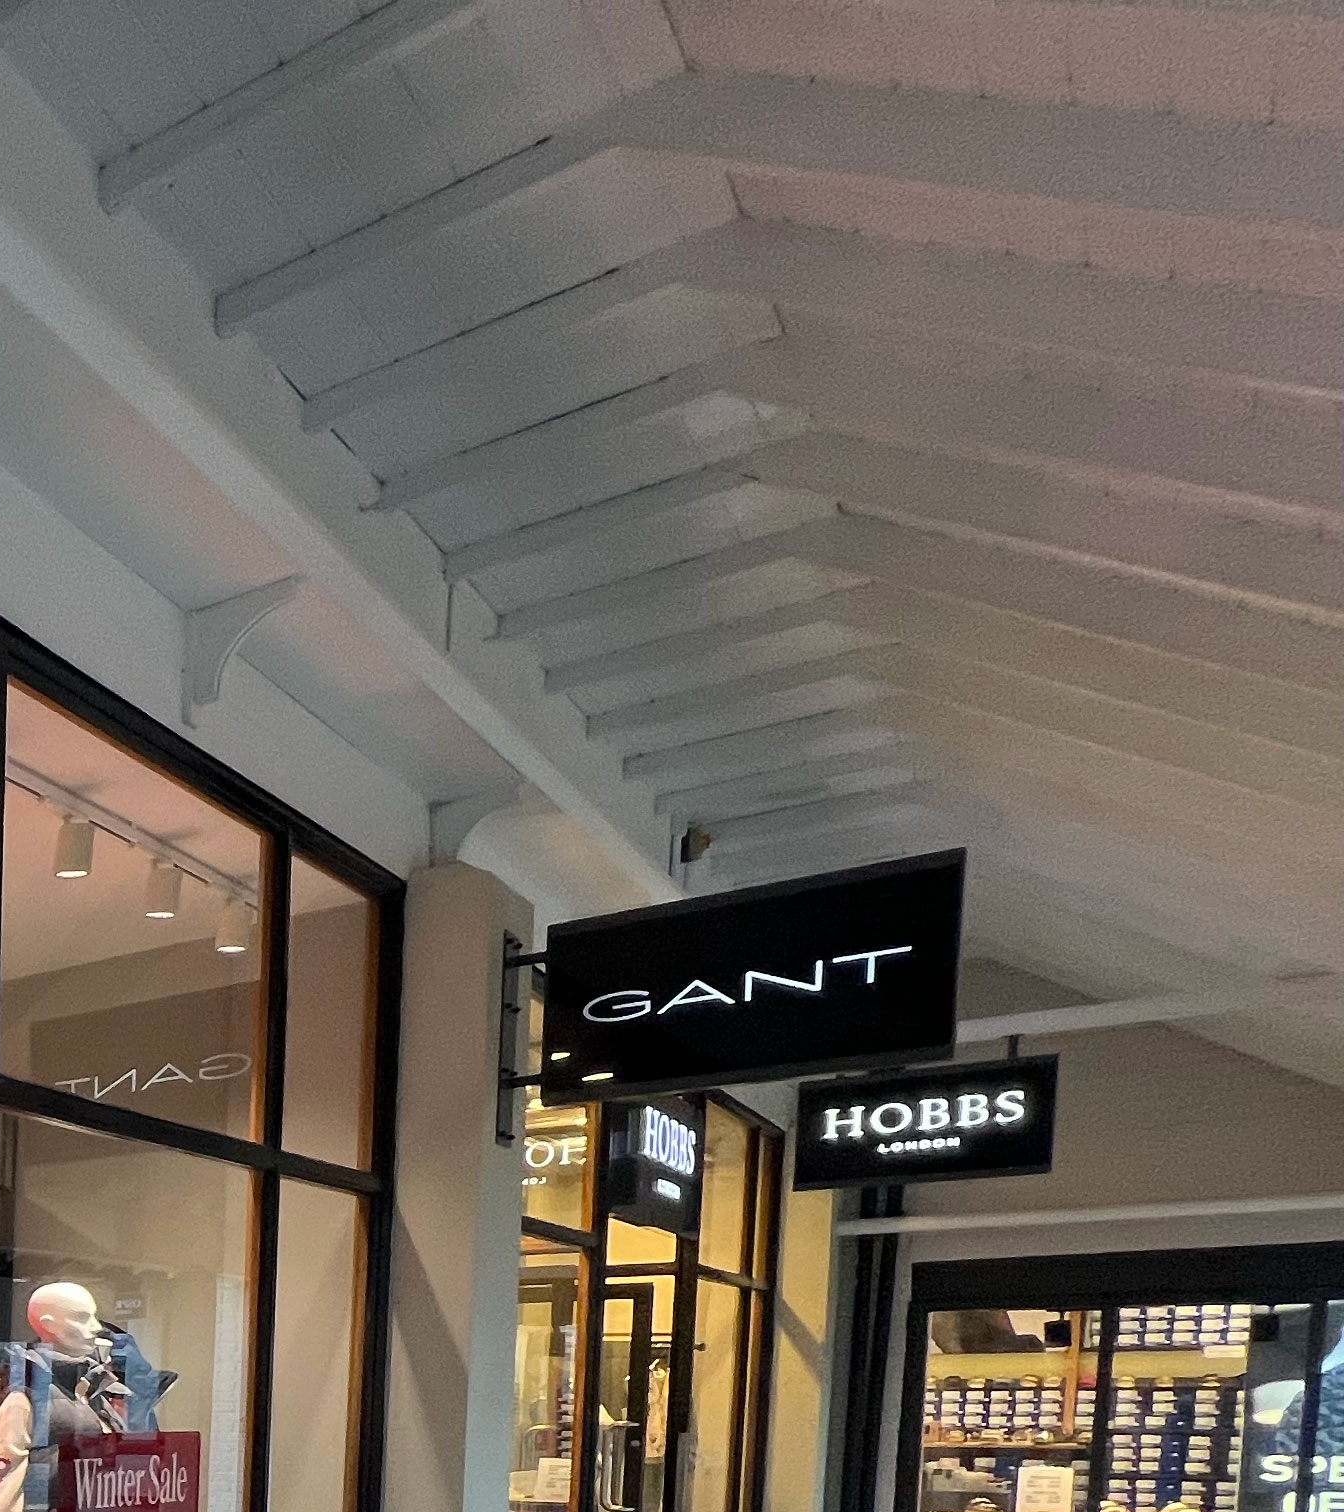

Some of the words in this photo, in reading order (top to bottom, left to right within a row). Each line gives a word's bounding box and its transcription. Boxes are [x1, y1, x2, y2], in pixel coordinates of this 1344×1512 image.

[582, 945, 914, 1023] GANT
[644, 1104, 698, 1176] HOBBS
[821, 1089, 1027, 1142] HOBBS
[876, 1136, 962, 1155] LONDON
[72, 1457, 146, 1511] Winter
[147, 1451, 188, 1506] Sale
